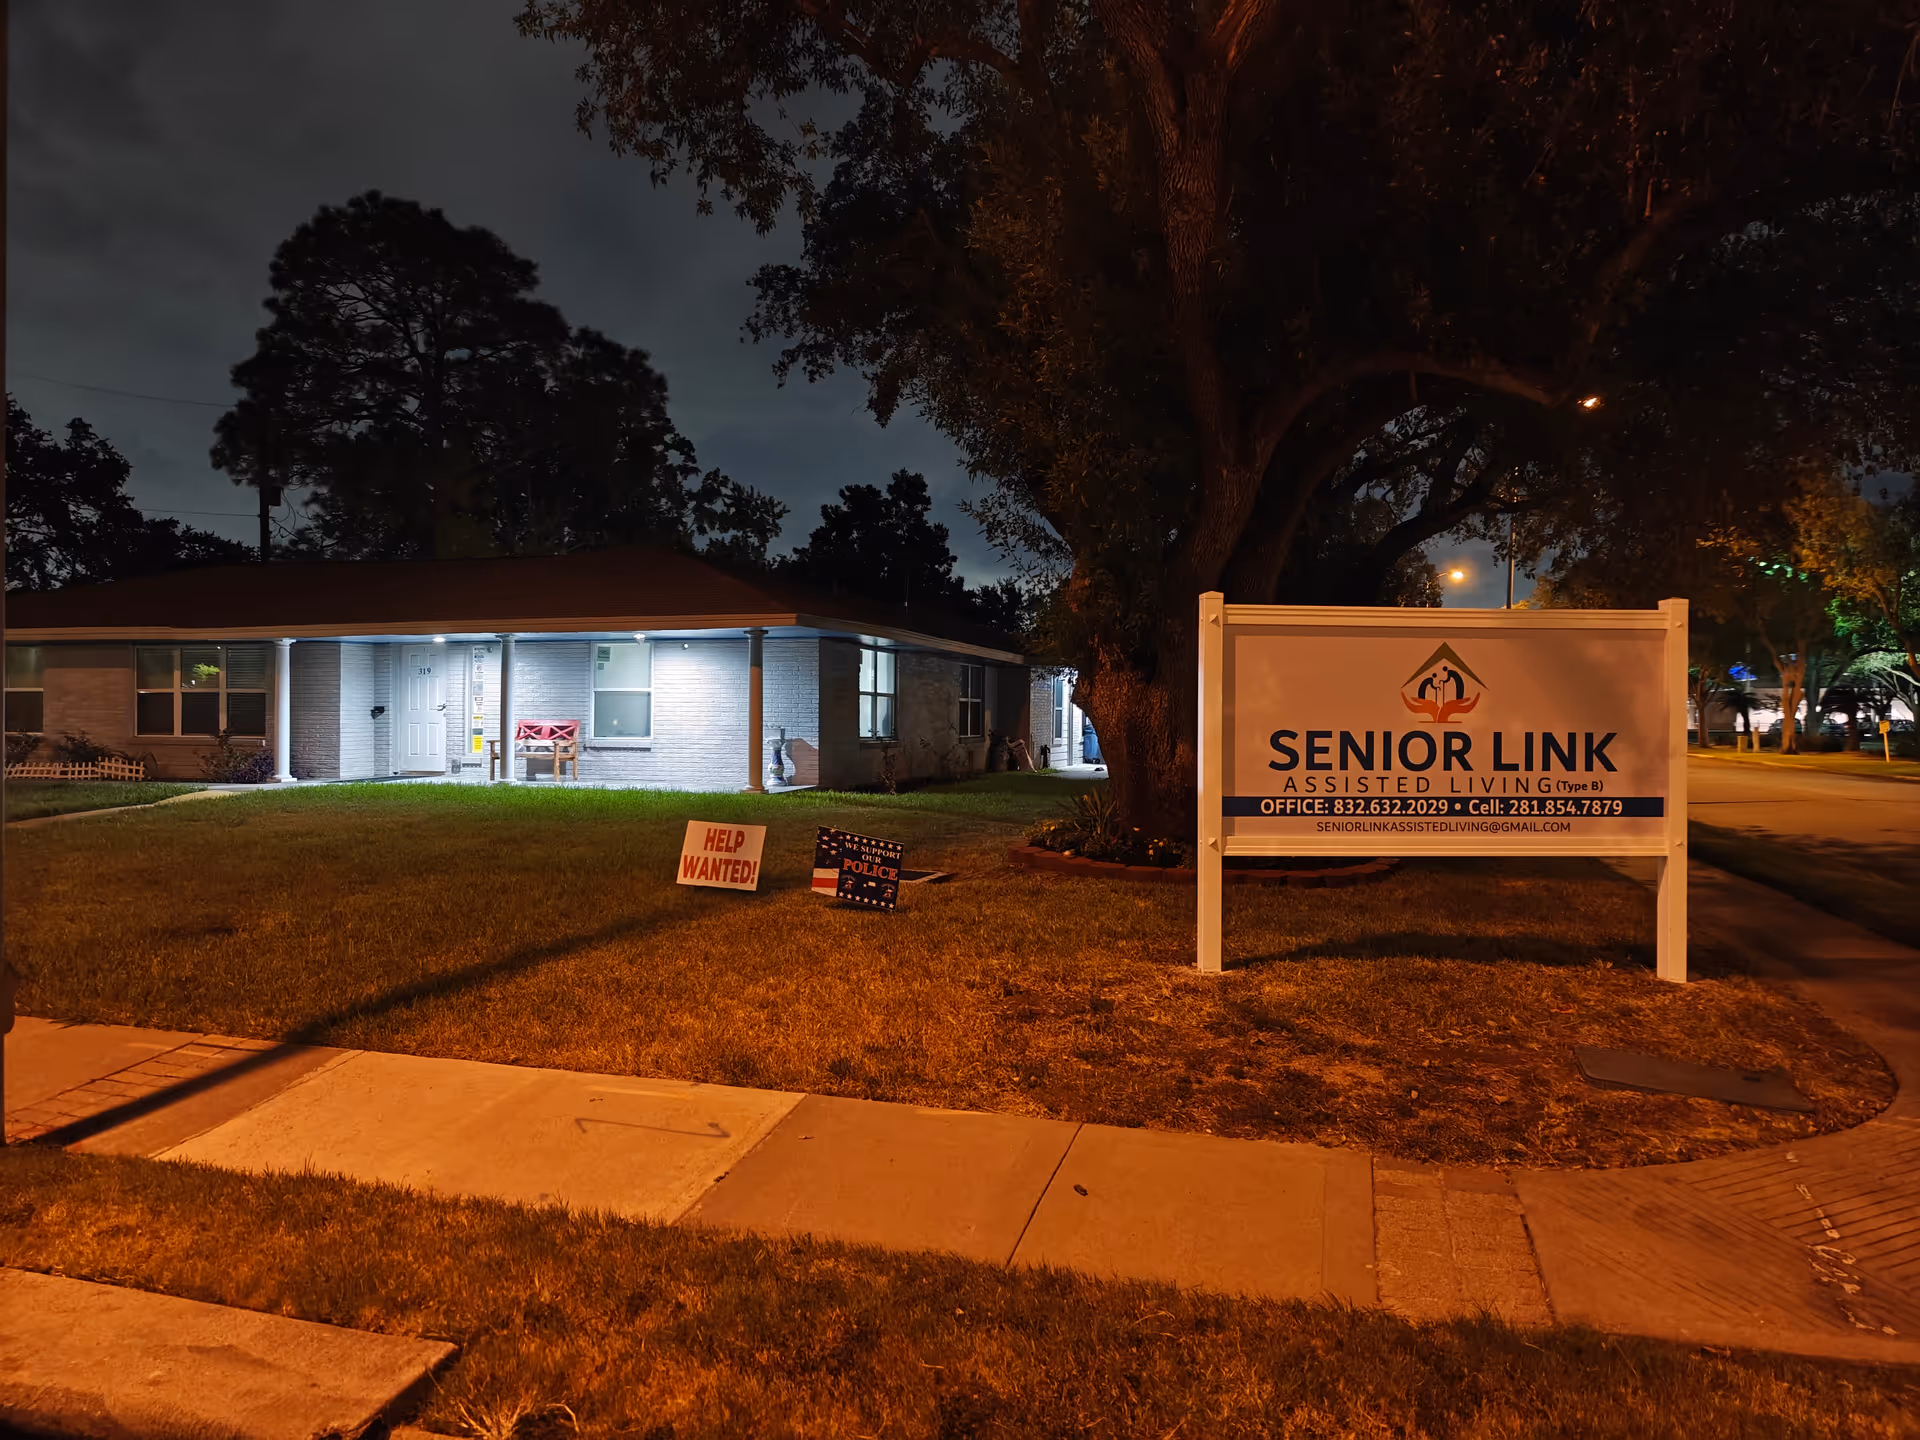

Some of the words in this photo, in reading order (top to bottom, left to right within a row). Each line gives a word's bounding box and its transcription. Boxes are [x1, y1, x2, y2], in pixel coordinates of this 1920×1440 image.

[1268, 729, 1473, 771] SENIOR
[1493, 731, 1618, 772] LINK
[1283, 776, 1430, 793] ASSISTED
[1450, 776, 1552, 793] LIVING
[1556, 780, 1588, 793] (Type
[1591, 780, 1604, 793] B)
[1260, 799, 1329, 815] OFFICE:
[1333, 799, 1448, 815] 832.632.2029
[1468, 799, 1505, 815] Cell:
[1509, 799, 1623, 816] 281.854.7879
[1316, 821, 1571, 833] SENIORLINKASSISTEDLIVING@GMAIL.COM
[704, 828, 745, 853] HELP
[845, 841, 859, 850] WE
[860, 845, 901, 859] SUPPORT
[861, 854, 881, 863] OUR
[683, 855, 757, 884] WANTED!
[843, 858, 898, 880] POLICE
